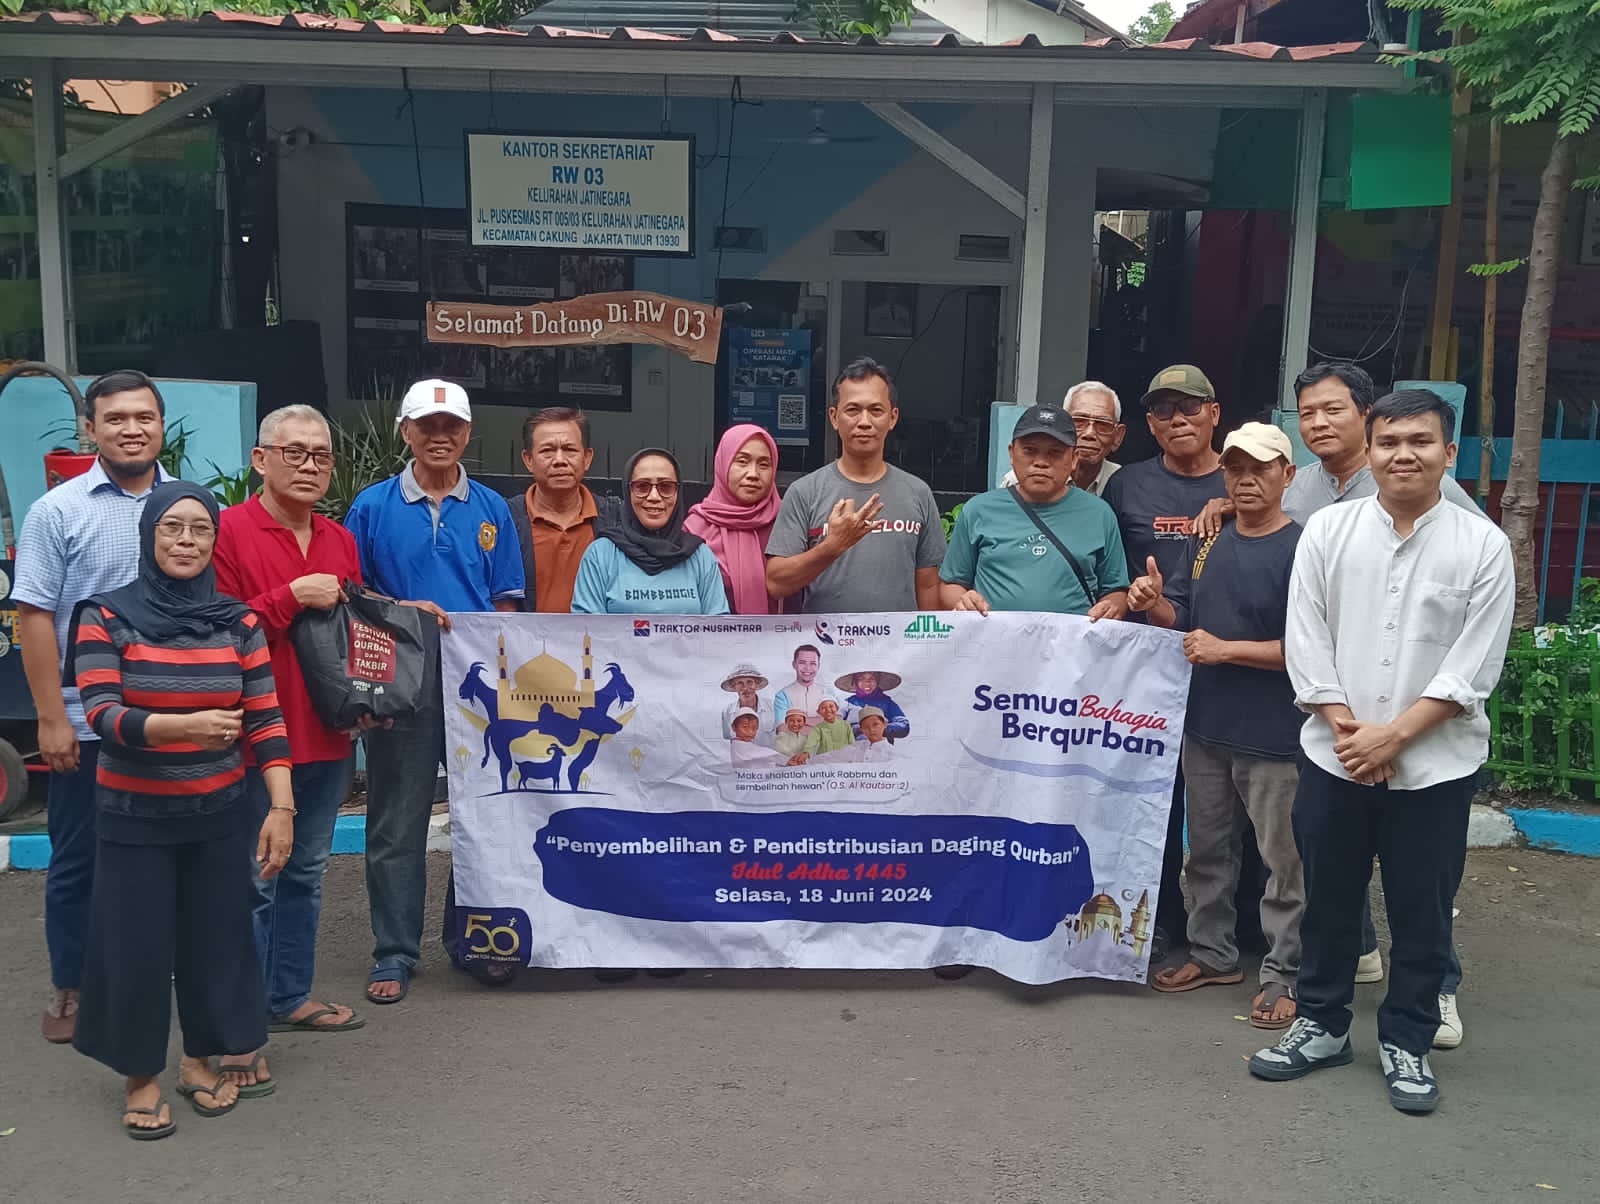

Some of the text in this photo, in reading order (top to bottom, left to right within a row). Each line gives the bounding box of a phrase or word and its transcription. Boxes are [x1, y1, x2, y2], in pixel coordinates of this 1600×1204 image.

[503, 141, 655, 160] KANTOR SEKRETARIAT
[552, 166, 604, 185] RW 03
[527, 187, 631, 207] KELURAHAN JATINEGARA
[477, 208, 685, 230] JL. PUSKESMAS RT 005/03 KELURAHAN JATINEGARA
[482, 230, 680, 247] KECAMATAN CAKUNG JAKARTA TIMUR 13930
[434, 309, 524, 335] Selamat
[531, 310, 603, 338] Datang
[673, 307, 706, 340] 03
[353, 623, 392, 641] FESTIVAL
[654, 624, 762, 633] TRAKTOR NUSANTARA
[837, 625, 890, 636] TRAKNUS
[354, 640, 391, 655] QURBAN
[838, 638, 855, 646] CSR
[355, 658, 387, 671] TAKBIR
[972, 684, 1168, 734] Semua Bahagia
[1001, 712, 1165, 757] Berqurban
[810, 769, 835, 779] untuk
[837, 770, 877, 779] Rabbmu
[879, 770, 898, 779] dan
[860, 781, 895, 790] Kautsar
[729, 838, 747, 854] &
[753, 838, 924, 854] Pendistribusian
[931, 836, 1006, 857] Daging
[731, 862, 907, 881] Idul Adha 1445
[714, 887, 932, 904] Selasa, 18 Juni 2024
[464, 914, 519, 956] 50
